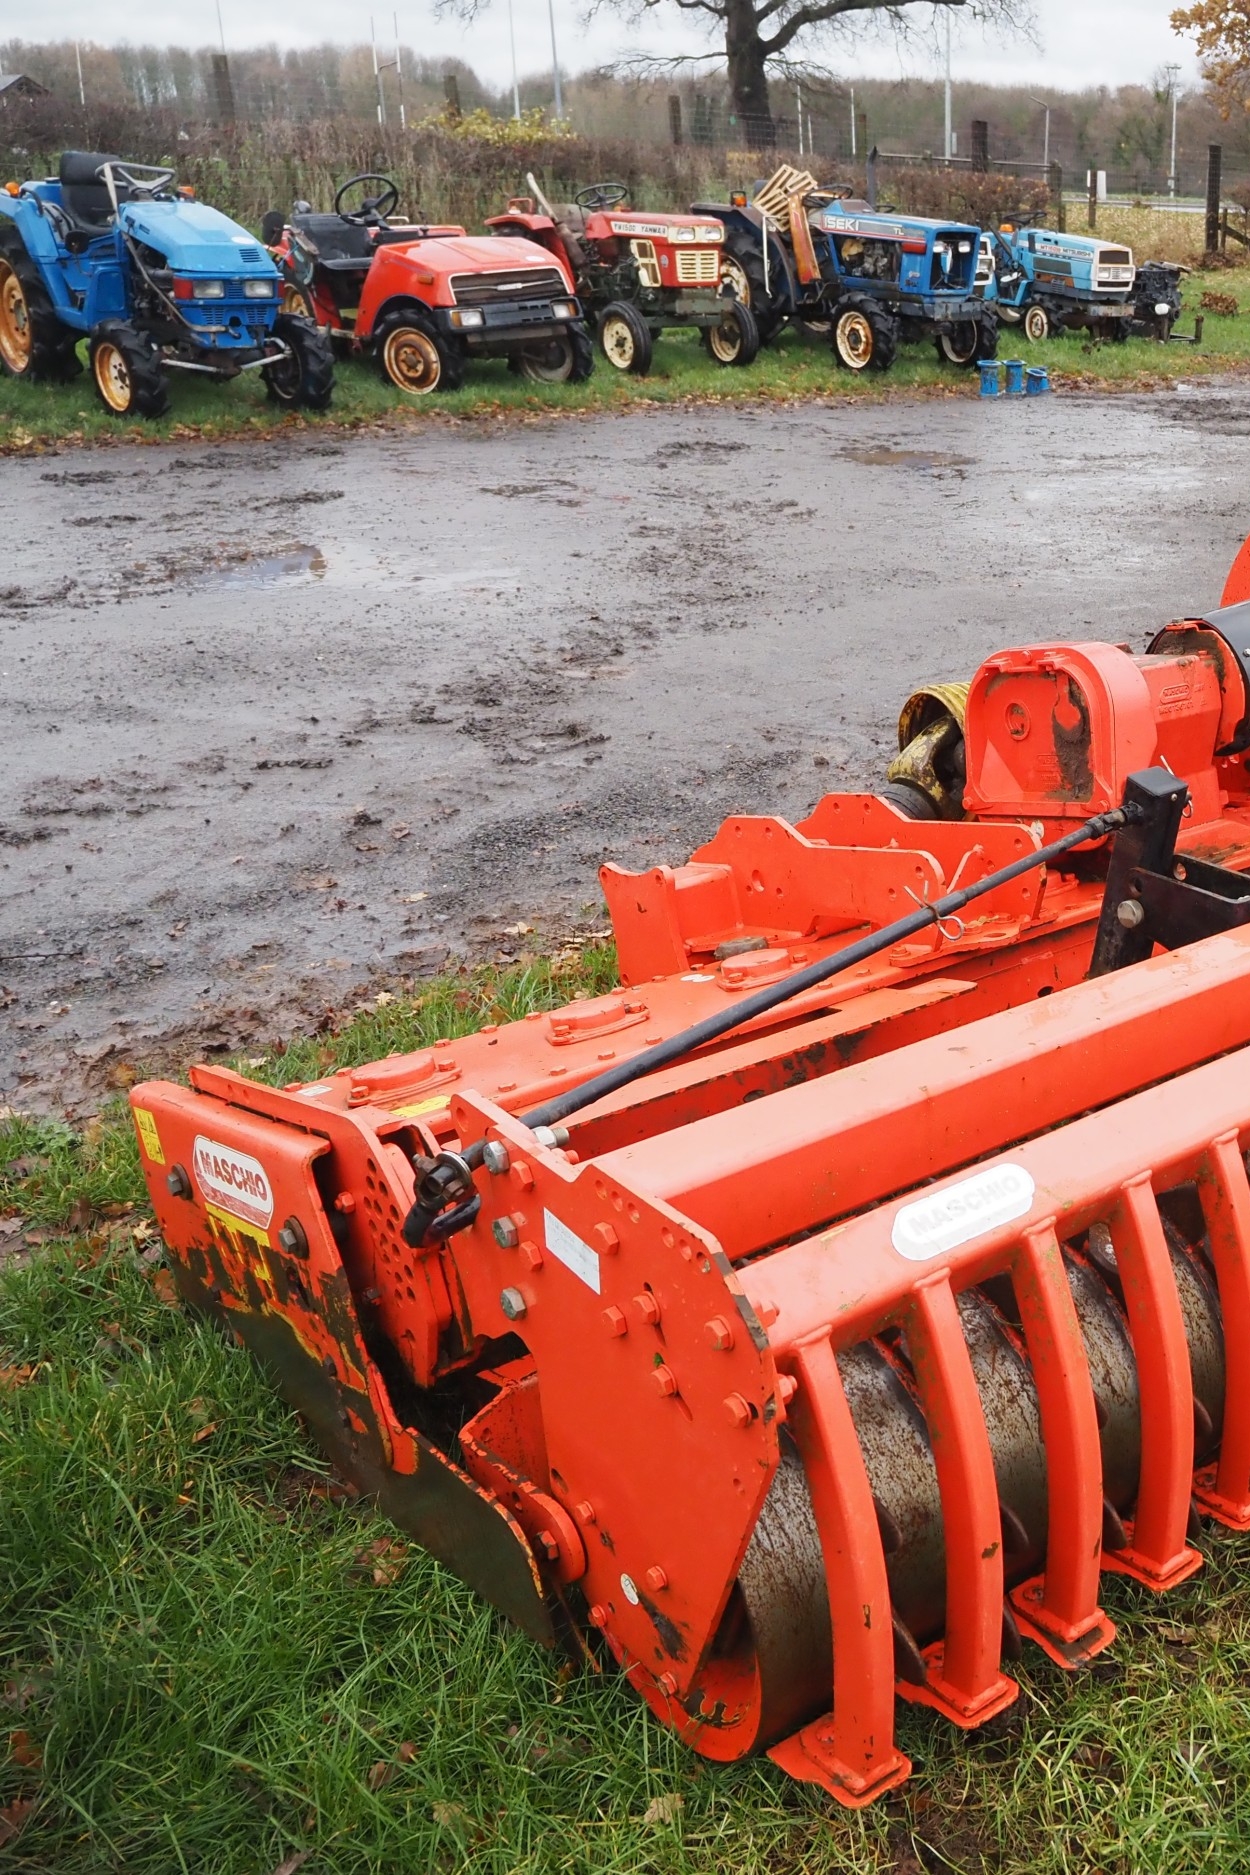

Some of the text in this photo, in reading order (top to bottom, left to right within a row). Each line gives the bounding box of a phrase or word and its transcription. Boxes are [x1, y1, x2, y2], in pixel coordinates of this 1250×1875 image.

[825, 215, 904, 236] ISEKI TL
[1062, 248, 1091, 258] MITSUBISHI
[199, 1148, 268, 1202] MASCHIO
[907, 1174, 1021, 1237] MASCHIO
